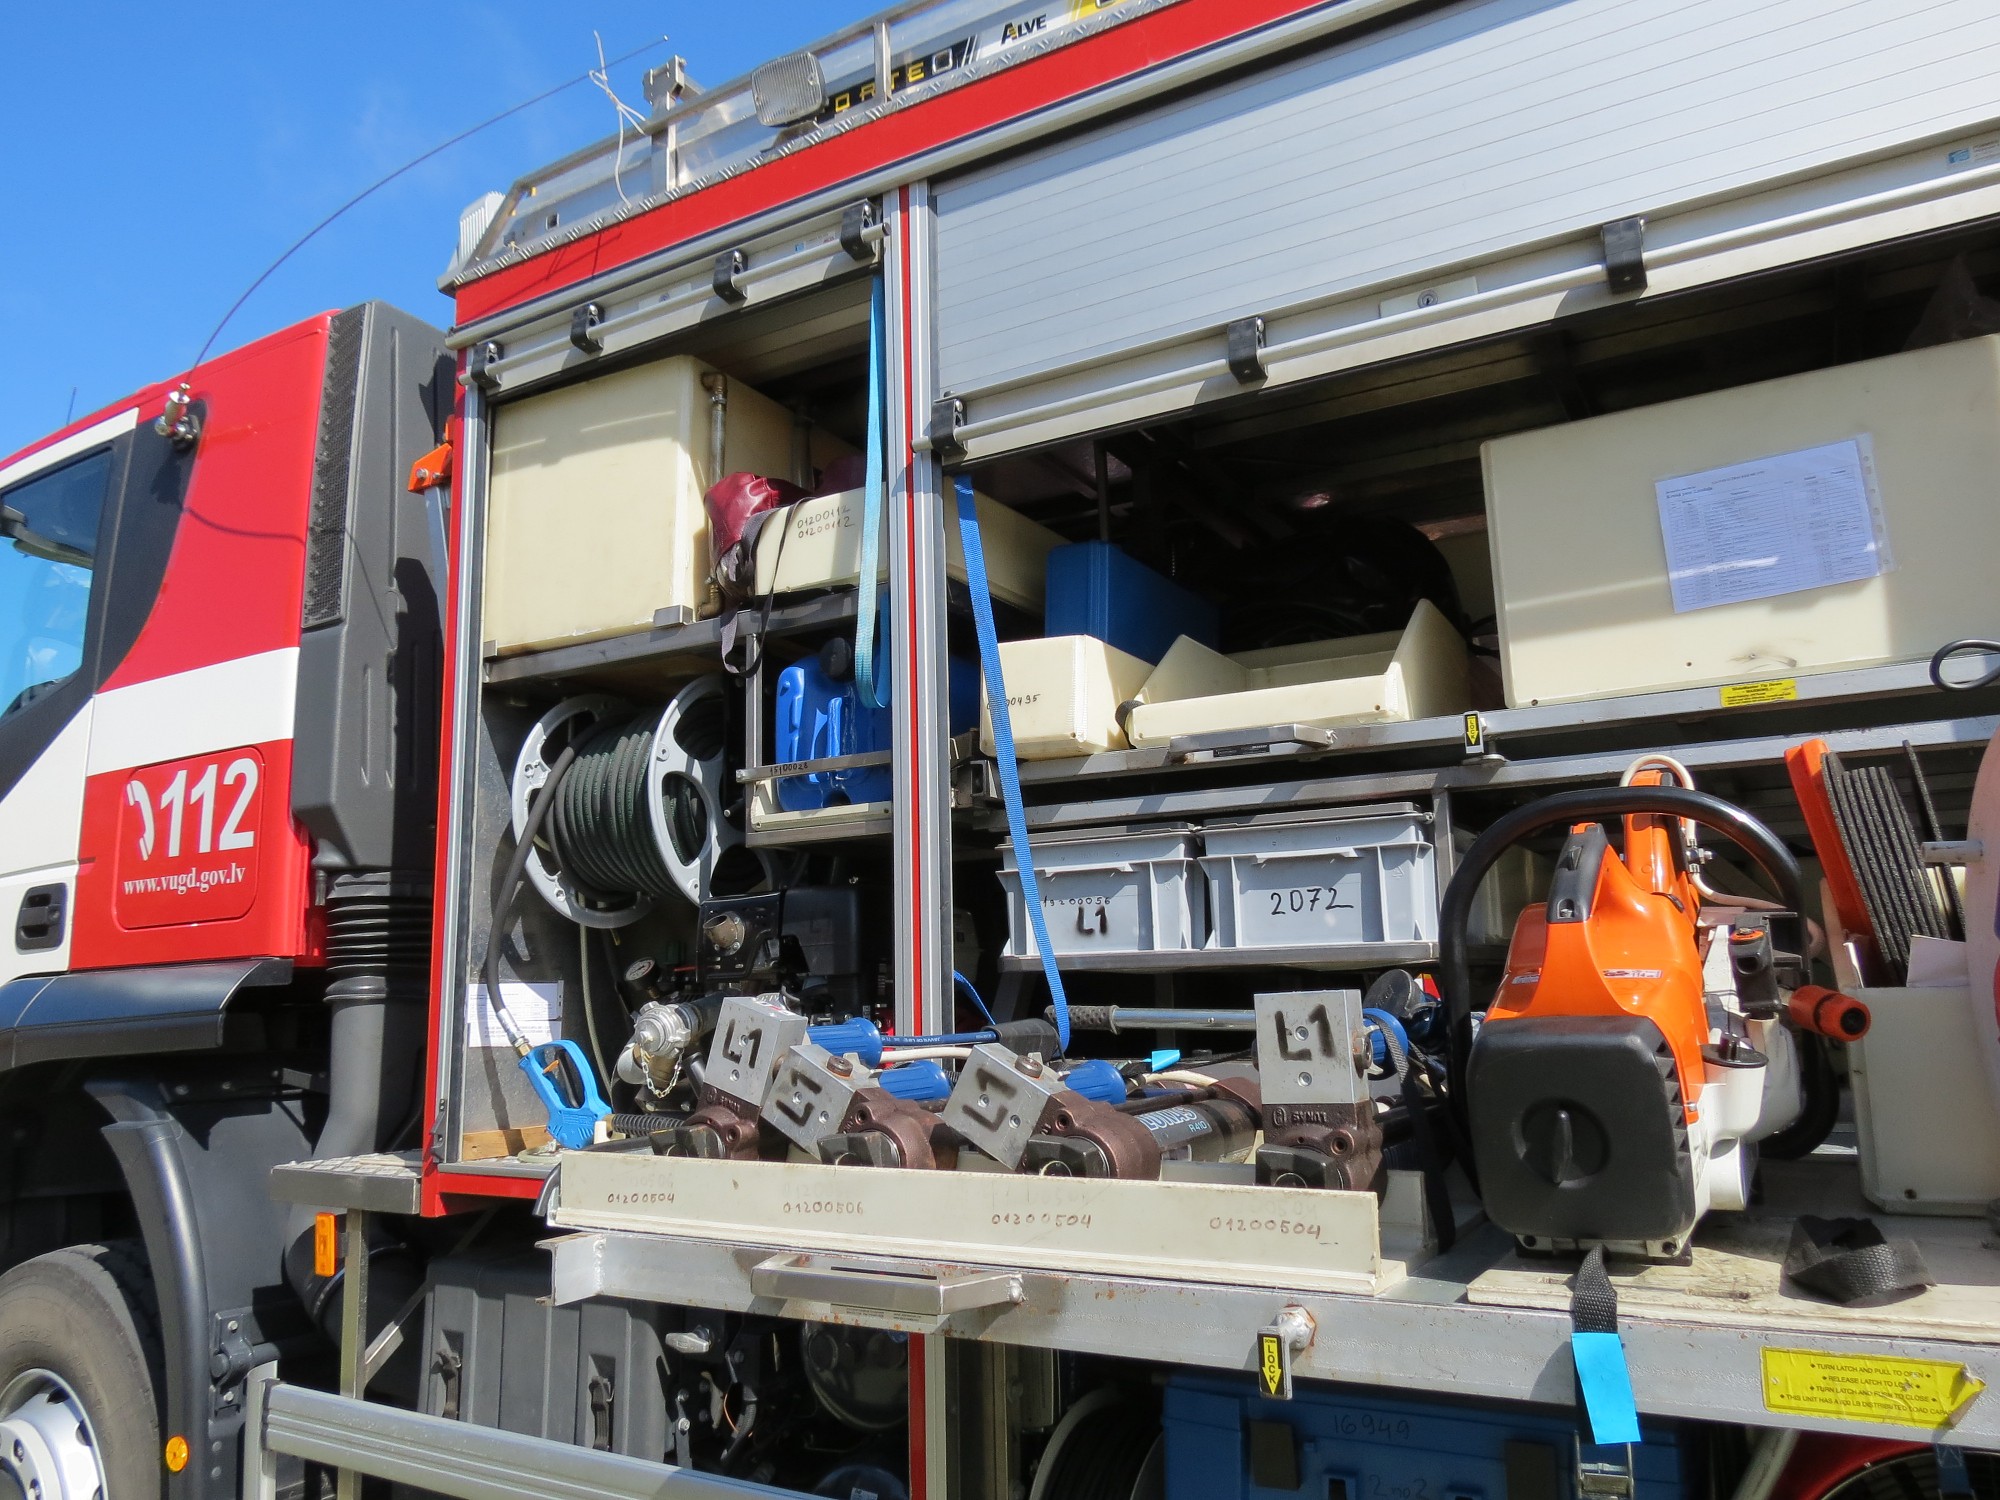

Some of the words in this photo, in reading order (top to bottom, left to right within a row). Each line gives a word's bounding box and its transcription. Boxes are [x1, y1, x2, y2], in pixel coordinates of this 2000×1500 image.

[1000, 13, 1047, 45] ALVE
[160, 758, 258, 857] 112
[123, 863, 246, 895] www.vugd.gov.lv
[1270, 888, 1354, 916] 2072
[1076, 905, 1107, 935] L1
[722, 1018, 763, 1069] L1
[1275, 1004, 1336, 1058] L1
[775, 1068, 823, 1127] L1
[960, 1066, 1018, 1133] L1
[1267, 1345, 1276, 1384] LOCK
[1828, 1376, 1859, 1384] RELEASE
[1906, 1394, 1929, 1402] CLOSE
